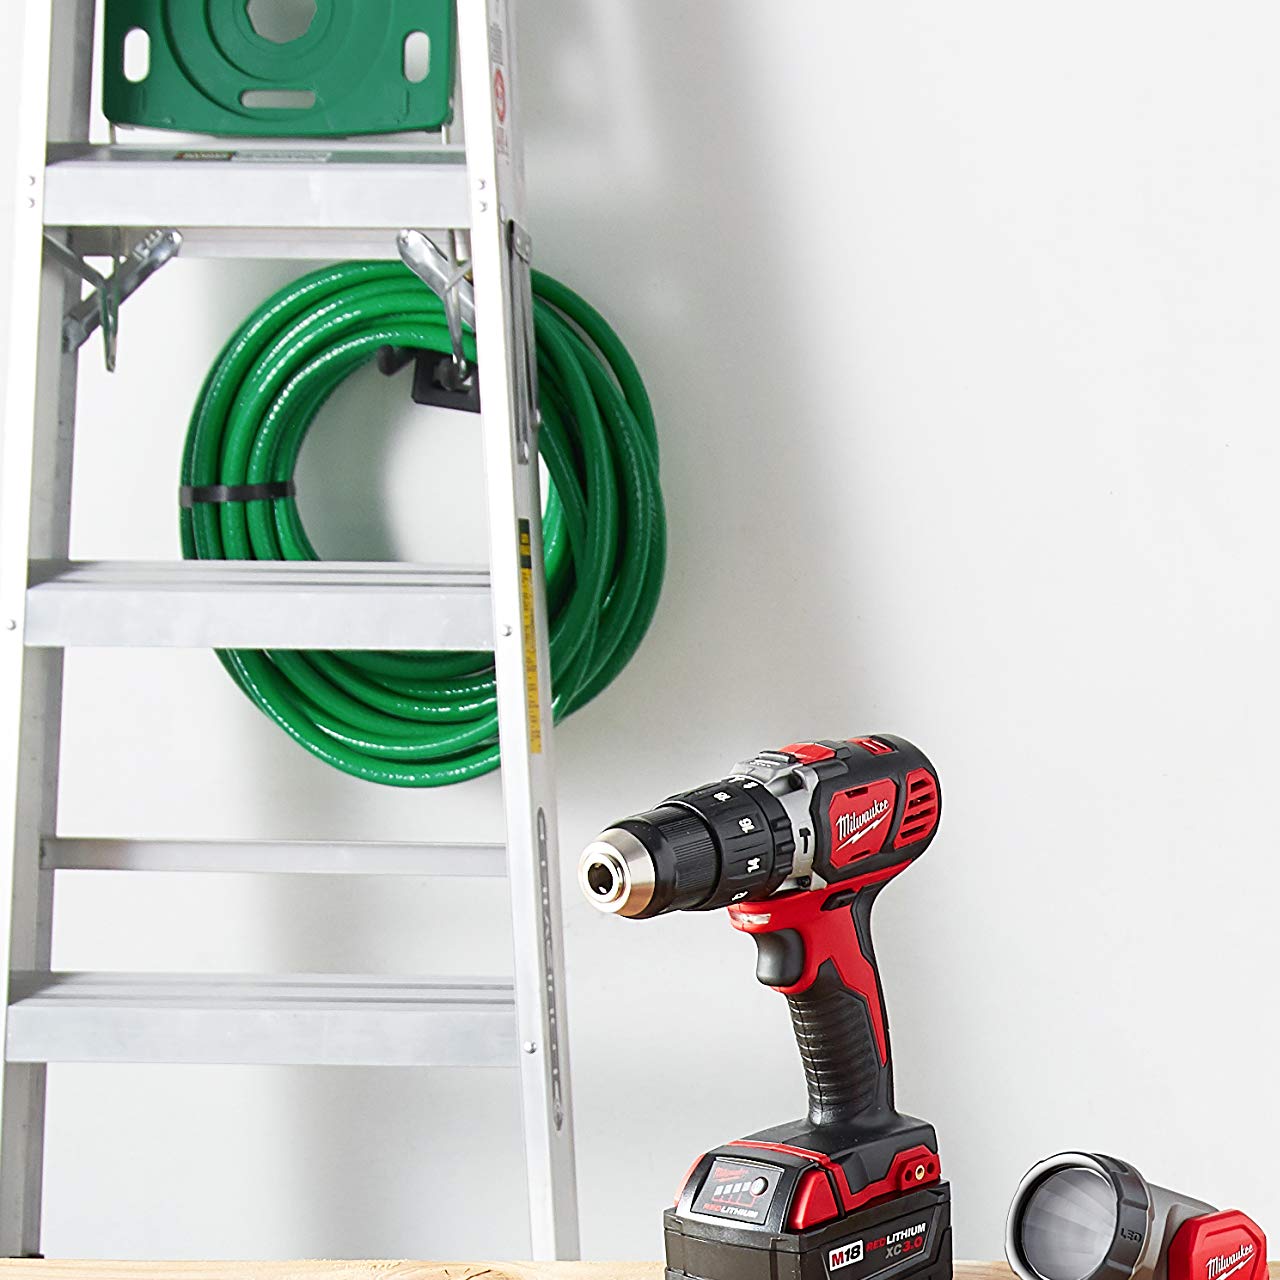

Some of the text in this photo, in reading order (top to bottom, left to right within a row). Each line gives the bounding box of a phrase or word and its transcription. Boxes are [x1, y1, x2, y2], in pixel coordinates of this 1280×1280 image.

[835, 799, 889, 841] Milwaukee
[1120, 1228, 1142, 1243] LED
[830, 1241, 862, 1268] M18
[1205, 1242, 1254, 1280] Milwaukee
